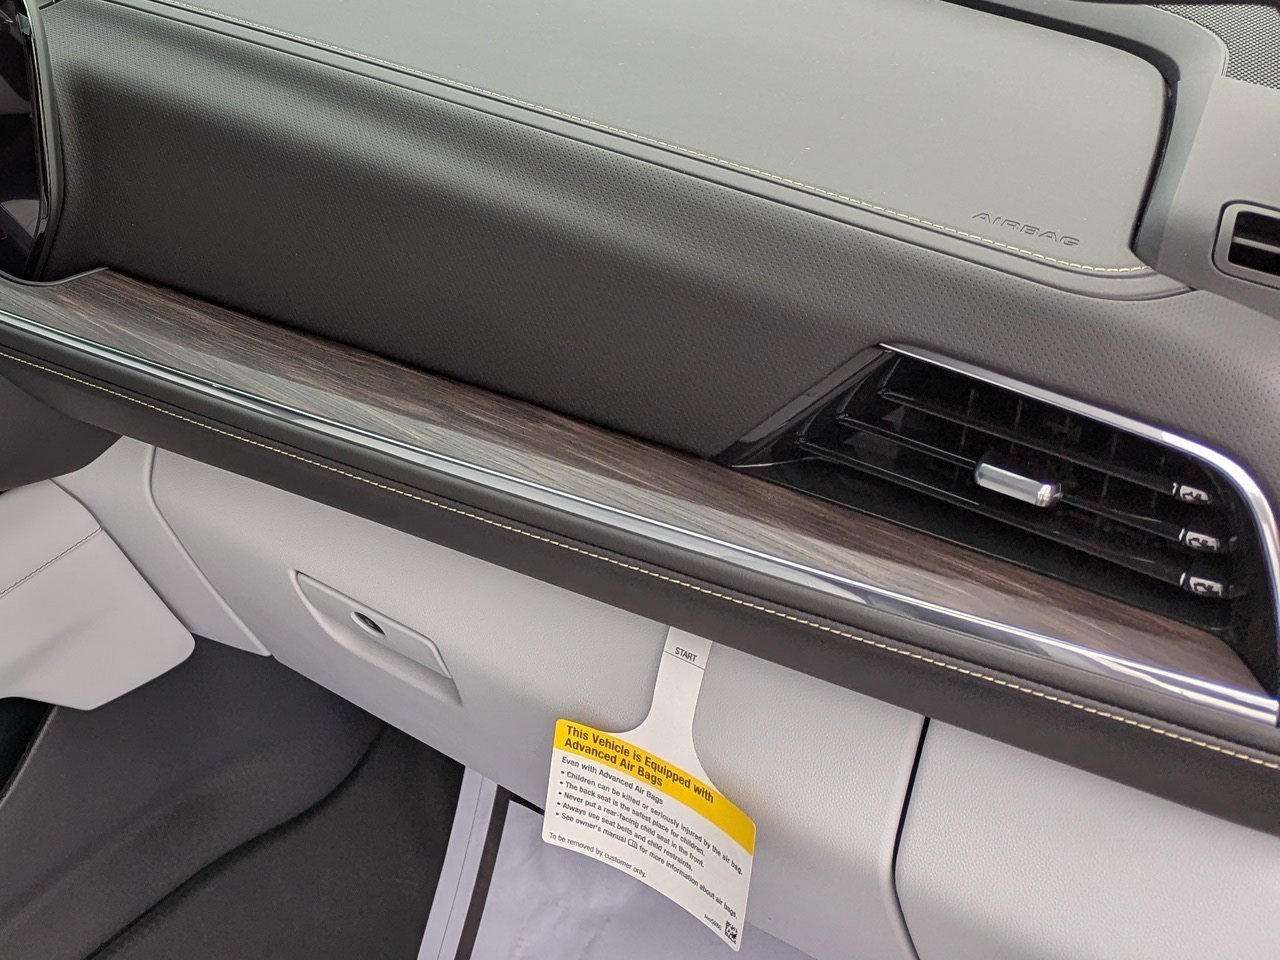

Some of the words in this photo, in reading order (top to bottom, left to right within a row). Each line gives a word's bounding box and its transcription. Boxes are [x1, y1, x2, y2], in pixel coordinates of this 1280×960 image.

[972, 212, 1079, 247] AIRBAG
[675, 647, 697, 662] START
[562, 756, 579, 767] Even
[582, 764, 598, 774] with
[599, 770, 633, 789] Advanced
[635, 785, 644, 795] Air
[647, 791, 663, 805] Bags
[564, 738, 617, 764] Advanced
[620, 759, 635, 772] Air
[638, 766, 662, 786] Bags
[567, 726, 588, 740] This
[592, 734, 630, 757] Vehicle
[633, 750, 642, 762] is
[644, 756, 691, 789] Equipped
[694, 784, 714, 803] with
[563, 802, 586, 816] Always
[588, 812, 600, 820] use
[602, 817, 615, 827] seat
[617, 823, 632, 835] belts
[634, 832, 646, 843] and
[647, 840, 662, 851] child
[664, 849, 693, 871] restraints.
[564, 792, 583, 803] Never
[585, 800, 596, 809] put
[604, 807, 639, 828] rear-facing
[640, 824, 655, 836] child
[657, 834, 670, 845] seat
[671, 841, 677, 849] in
[679, 846, 688, 856] the
[689, 852, 704, 868] front.
[566, 781, 578, 791] The
[580, 786, 595, 797] back
[597, 794, 611, 803] seat
[620, 802, 630, 812] the
[632, 809, 651, 823] safest
[652, 820, 669, 833] place
[671, 829, 679, 838] for
[680, 835, 705, 856] children.
[567, 771, 595, 786] Children
[598, 783, 610, 792] can
[612, 787, 620, 796] be
[622, 792, 640, 806] killed
[651, 807, 679, 828] seriously
[681, 823, 704, 842] injured
[704, 839, 711, 849] by
[712, 844, 721, 856] the
[722, 853, 730, 864] air
[550, 832, 556, 840] To
[558, 834, 566, 842] be
[568, 839, 594, 852] removed
[596, 848, 603, 856] by
[605, 853, 632, 869] customer
[633, 867, 646, 878] only.
[562, 813, 573, 821] See
[576, 818, 601, 832] owner's
[603, 828, 626, 843] manual
[640, 845, 648, 854] for
[649, 853, 665, 864] more
[666, 861, 698, 887] information
[700, 884, 715, 900] about
